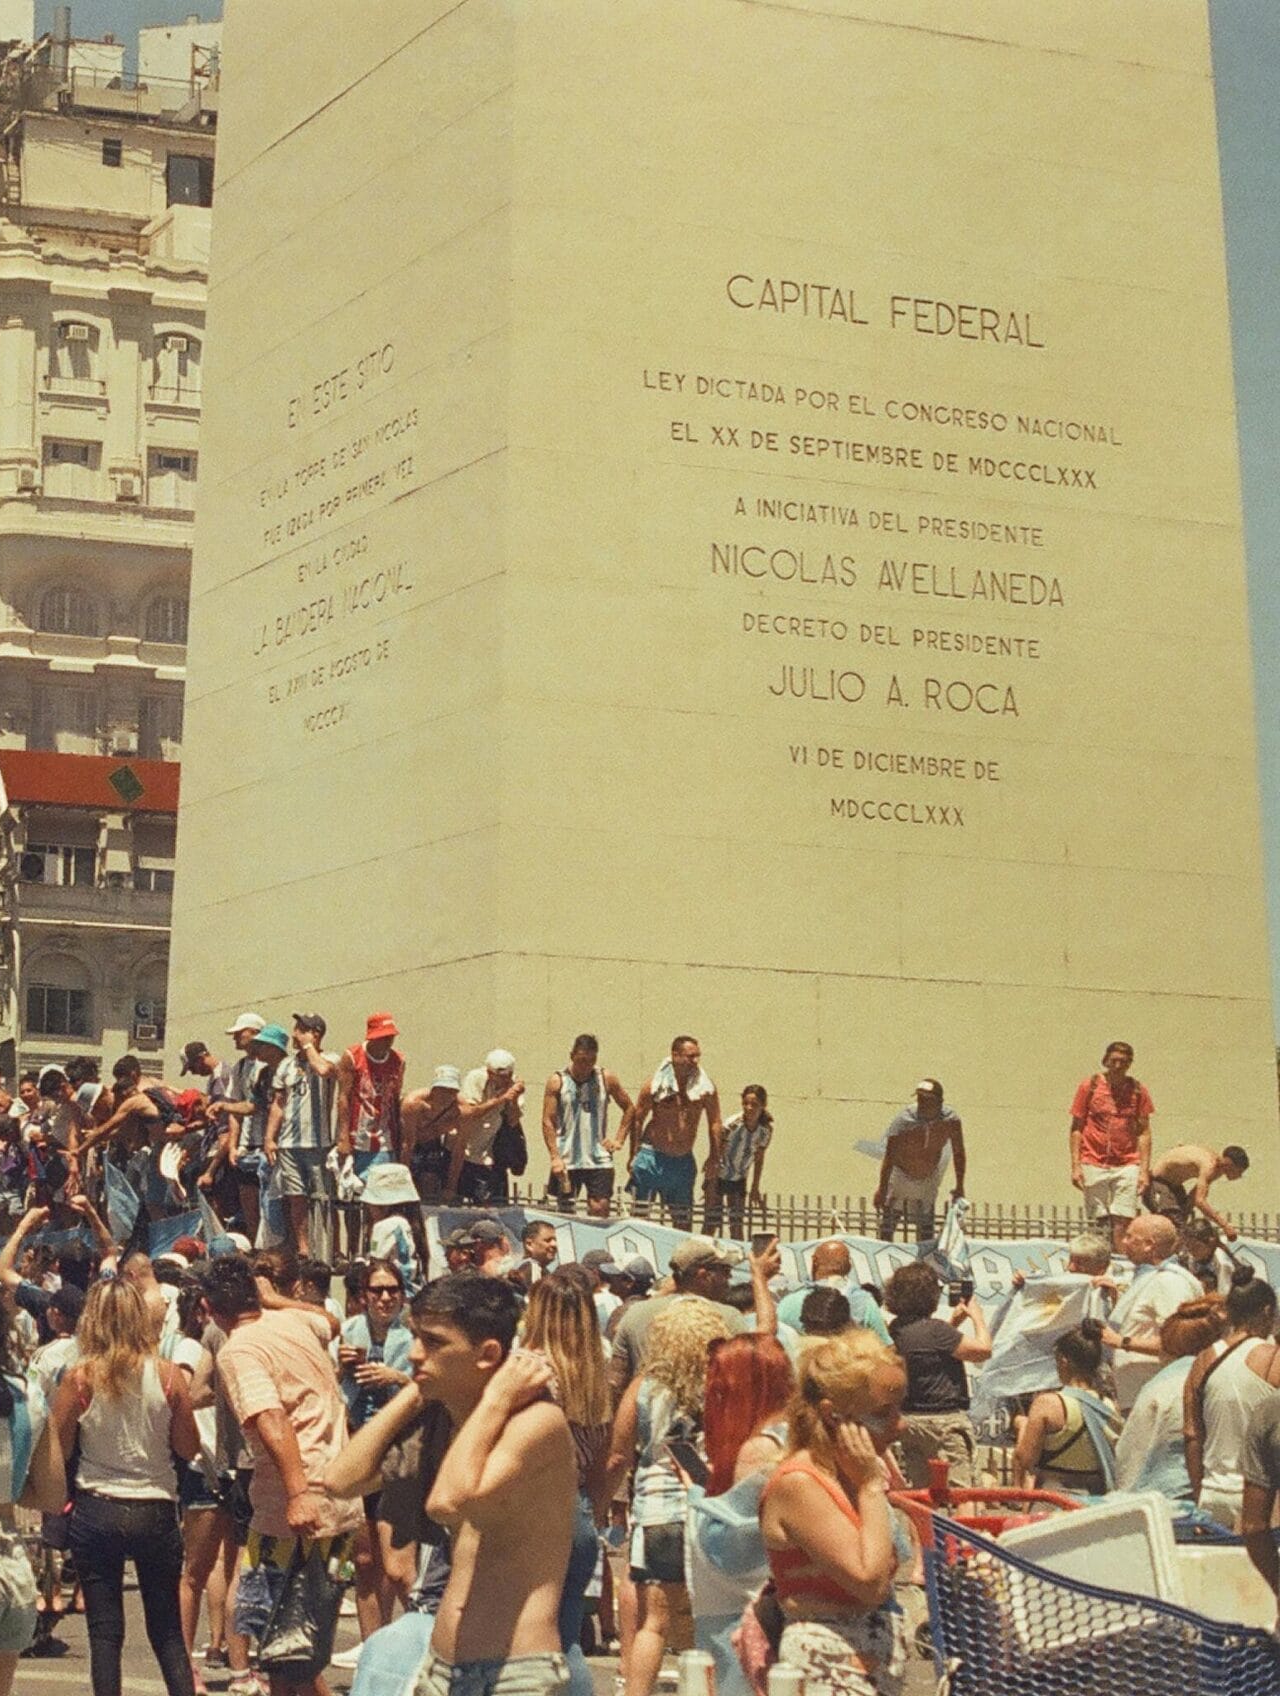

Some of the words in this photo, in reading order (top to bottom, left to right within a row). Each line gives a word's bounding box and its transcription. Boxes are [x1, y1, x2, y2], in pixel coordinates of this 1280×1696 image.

[725, 273, 869, 326] CAPITAL
[890, 295, 1045, 348] FEDERAL
[313, 368, 349, 415] ESTE
[356, 343, 395, 390] SITIO
[643, 368, 687, 392] LEY
[696, 374, 787, 405] DICTADA
[795, 387, 839, 412] POR
[849, 395, 876, 418] EL
[885, 399, 1008, 433] CONGRESO
[1018, 416, 1123, 447] NACIONAL
[332, 447, 347, 470] DE
[352, 435, 370, 460] SAN
[374, 408, 418, 447] NICOLAS
[670, 421, 699, 443] EL
[711, 426, 741, 448] XX
[751, 430, 780, 453] DE
[790, 434, 924, 470] SEPTIEMBRE
[933, 451, 960, 473] DE
[968, 456, 1098, 491] MDCCCLXXX
[320, 496, 340, 518] POR
[734, 497, 748, 517] A
[757, 497, 860, 529] INICIATIVA
[869, 510, 909, 534] DEL
[918, 515, 1045, 548] PRESIDENTE
[710, 542, 858, 588] NICOLAS
[877, 558, 1065, 608] AVELLANEDA
[276, 595, 334, 646] BANDERA
[743, 612, 849, 642] DECRETO
[860, 624, 901, 647] DEL
[913, 628, 1041, 660] PRESIDENTE
[269, 685, 280, 704] EL
[312, 667, 325, 687] DE
[376, 639, 390, 661] DE
[769, 664, 867, 704] JULIO
[885, 675, 910, 708] A.
[925, 677, 1020, 718] ROCA
[789, 745, 808, 766] VI
[818, 748, 845, 770] DE
[854, 750, 966, 780] DICIEMBRE
[974, 760, 1000, 782] DE
[830, 798, 965, 827] MDCCCLXXX
